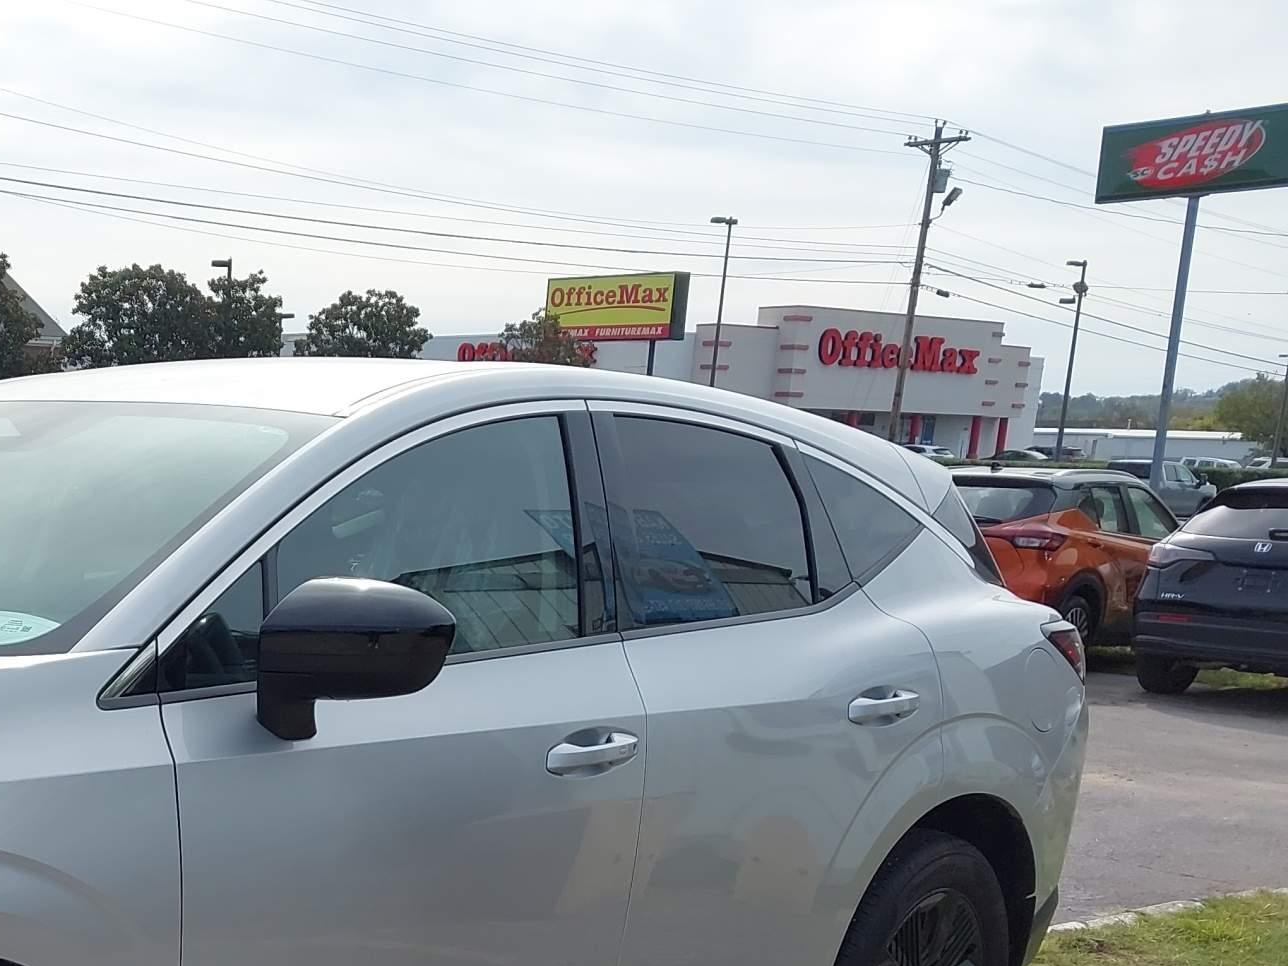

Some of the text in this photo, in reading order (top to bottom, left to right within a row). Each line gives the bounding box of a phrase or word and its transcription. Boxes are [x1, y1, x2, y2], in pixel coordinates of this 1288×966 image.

[1155, 120, 1264, 164] SPEEDY
[1156, 149, 1248, 181] CA$H
[550, 283, 670, 307] OfficeMax
[595, 326, 663, 337] FURNITUREMAX
